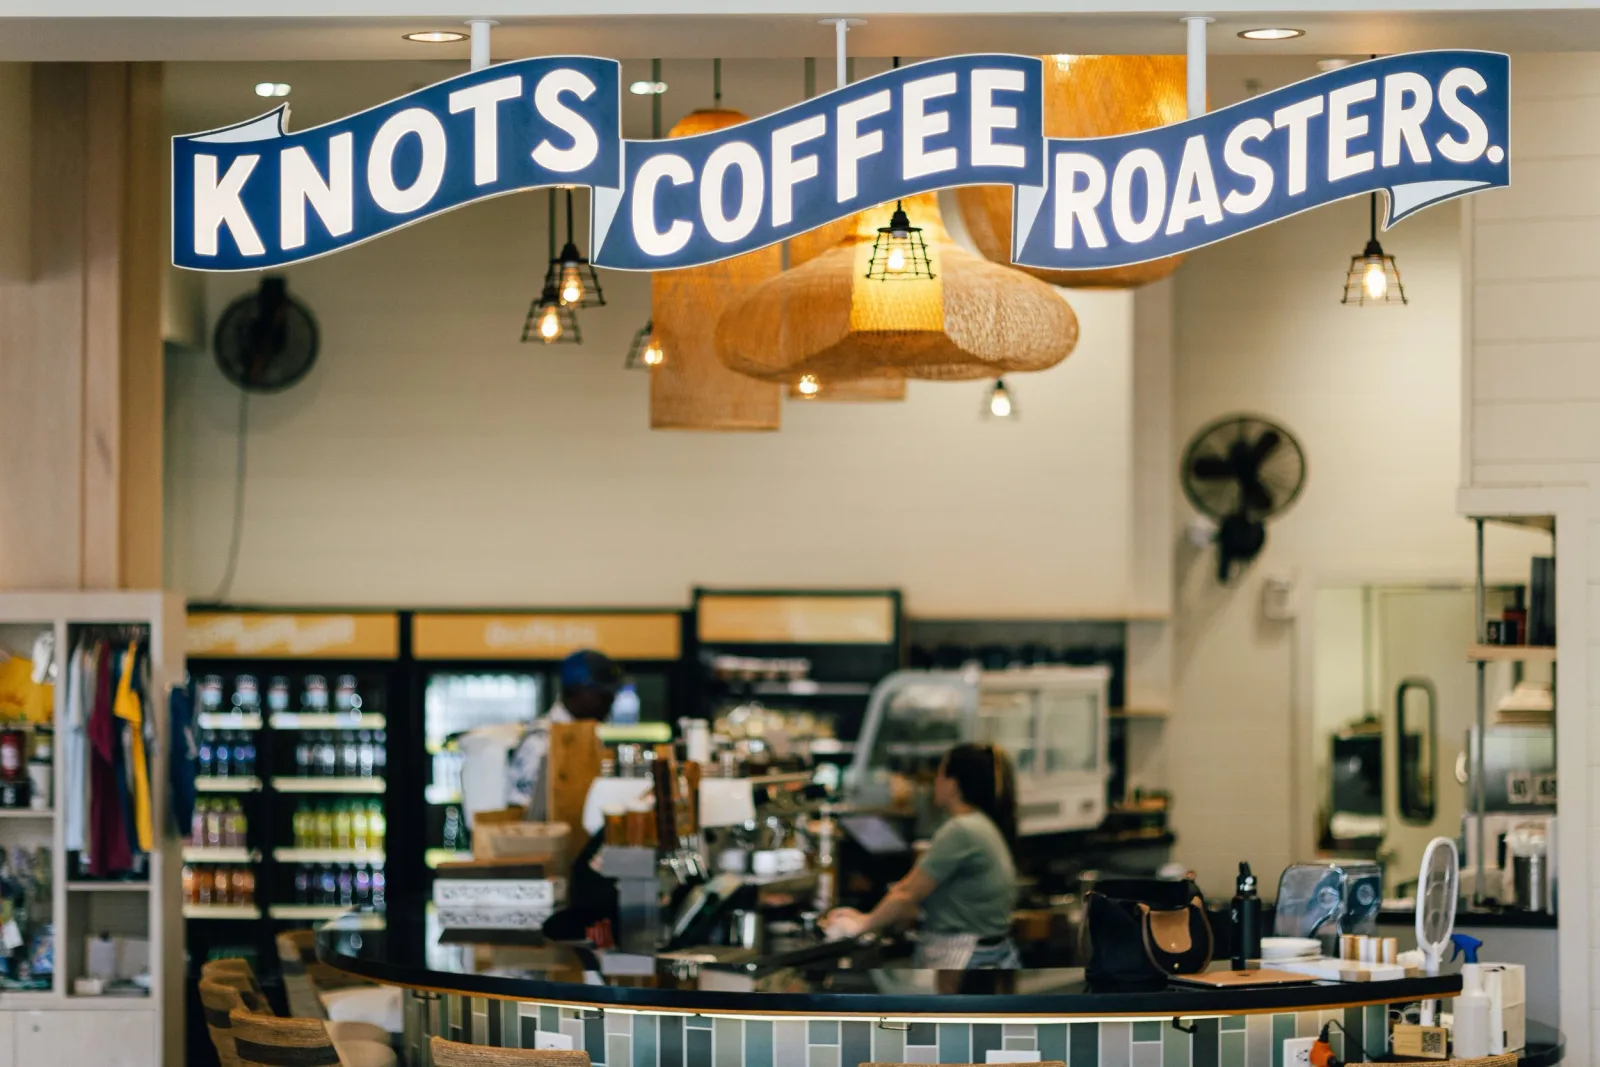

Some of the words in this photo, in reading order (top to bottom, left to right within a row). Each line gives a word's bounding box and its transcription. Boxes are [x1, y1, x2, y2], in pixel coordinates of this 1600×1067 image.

[193, 68, 600, 256] KNOTS
[631, 68, 1027, 257] COFFEE
[1053, 67, 1505, 250] ROASTERS.
